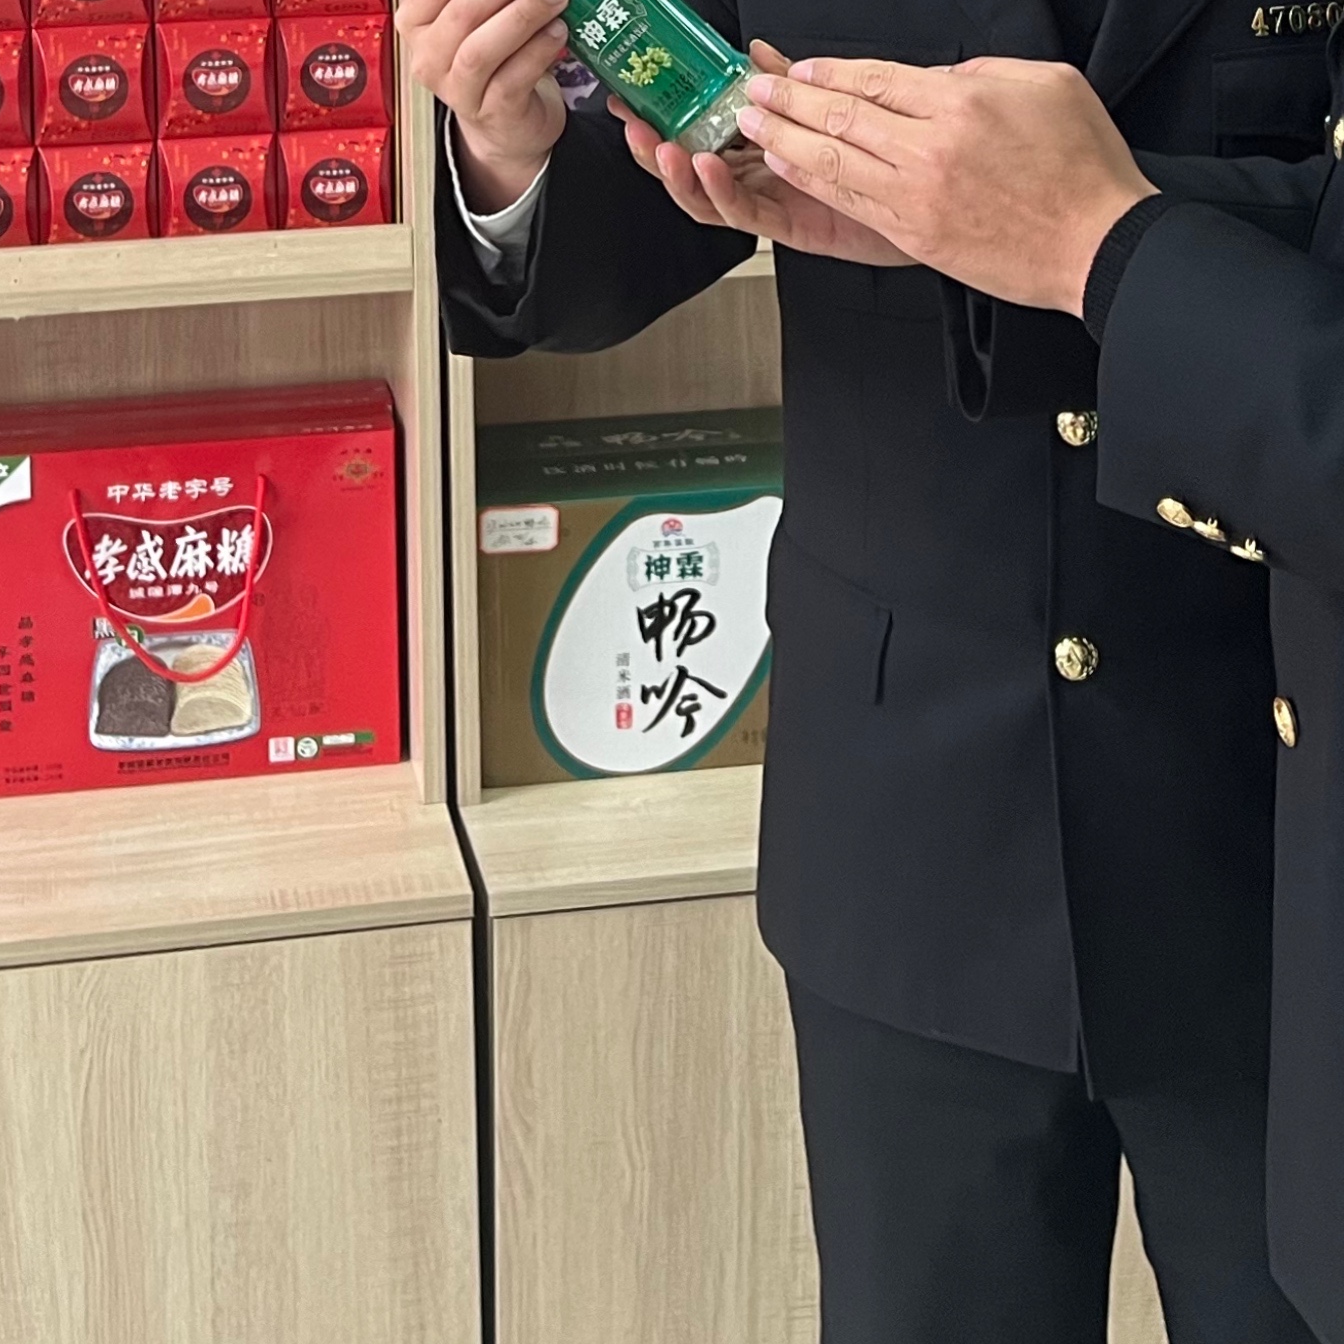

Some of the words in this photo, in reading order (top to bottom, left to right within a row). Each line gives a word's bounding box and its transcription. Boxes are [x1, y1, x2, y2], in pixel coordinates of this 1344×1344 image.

[106, 476, 234, 503] 中华老字号
[86, 525, 256, 584] 孝感麻糖
[645, 551, 704, 581] 神霖
